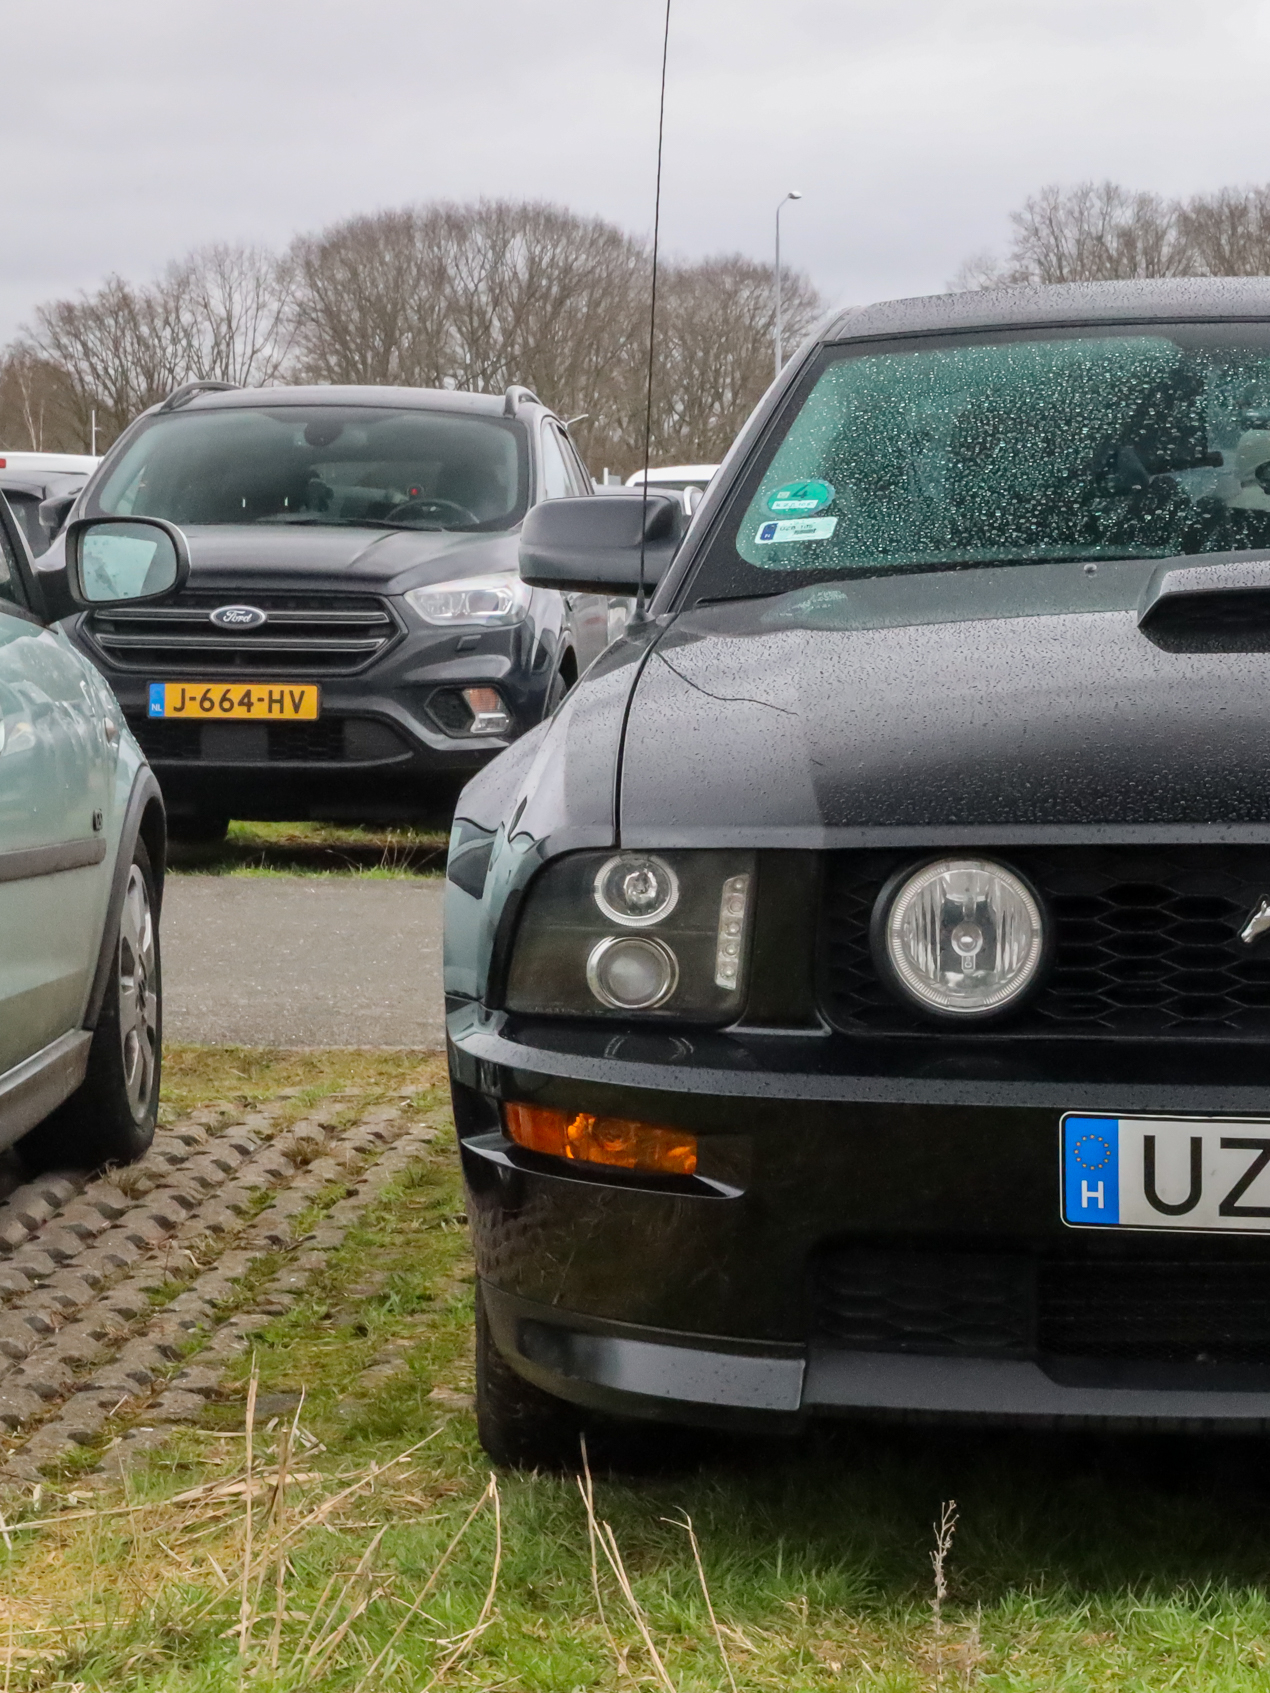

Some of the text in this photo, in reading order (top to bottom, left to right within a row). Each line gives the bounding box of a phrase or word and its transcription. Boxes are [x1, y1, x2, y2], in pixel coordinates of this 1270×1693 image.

[223, 610, 252, 623] Ford
[151, 704, 162, 712] NL
[173, 688, 305, 714] J-664-HV
[1081, 1180, 1105, 1209] H
